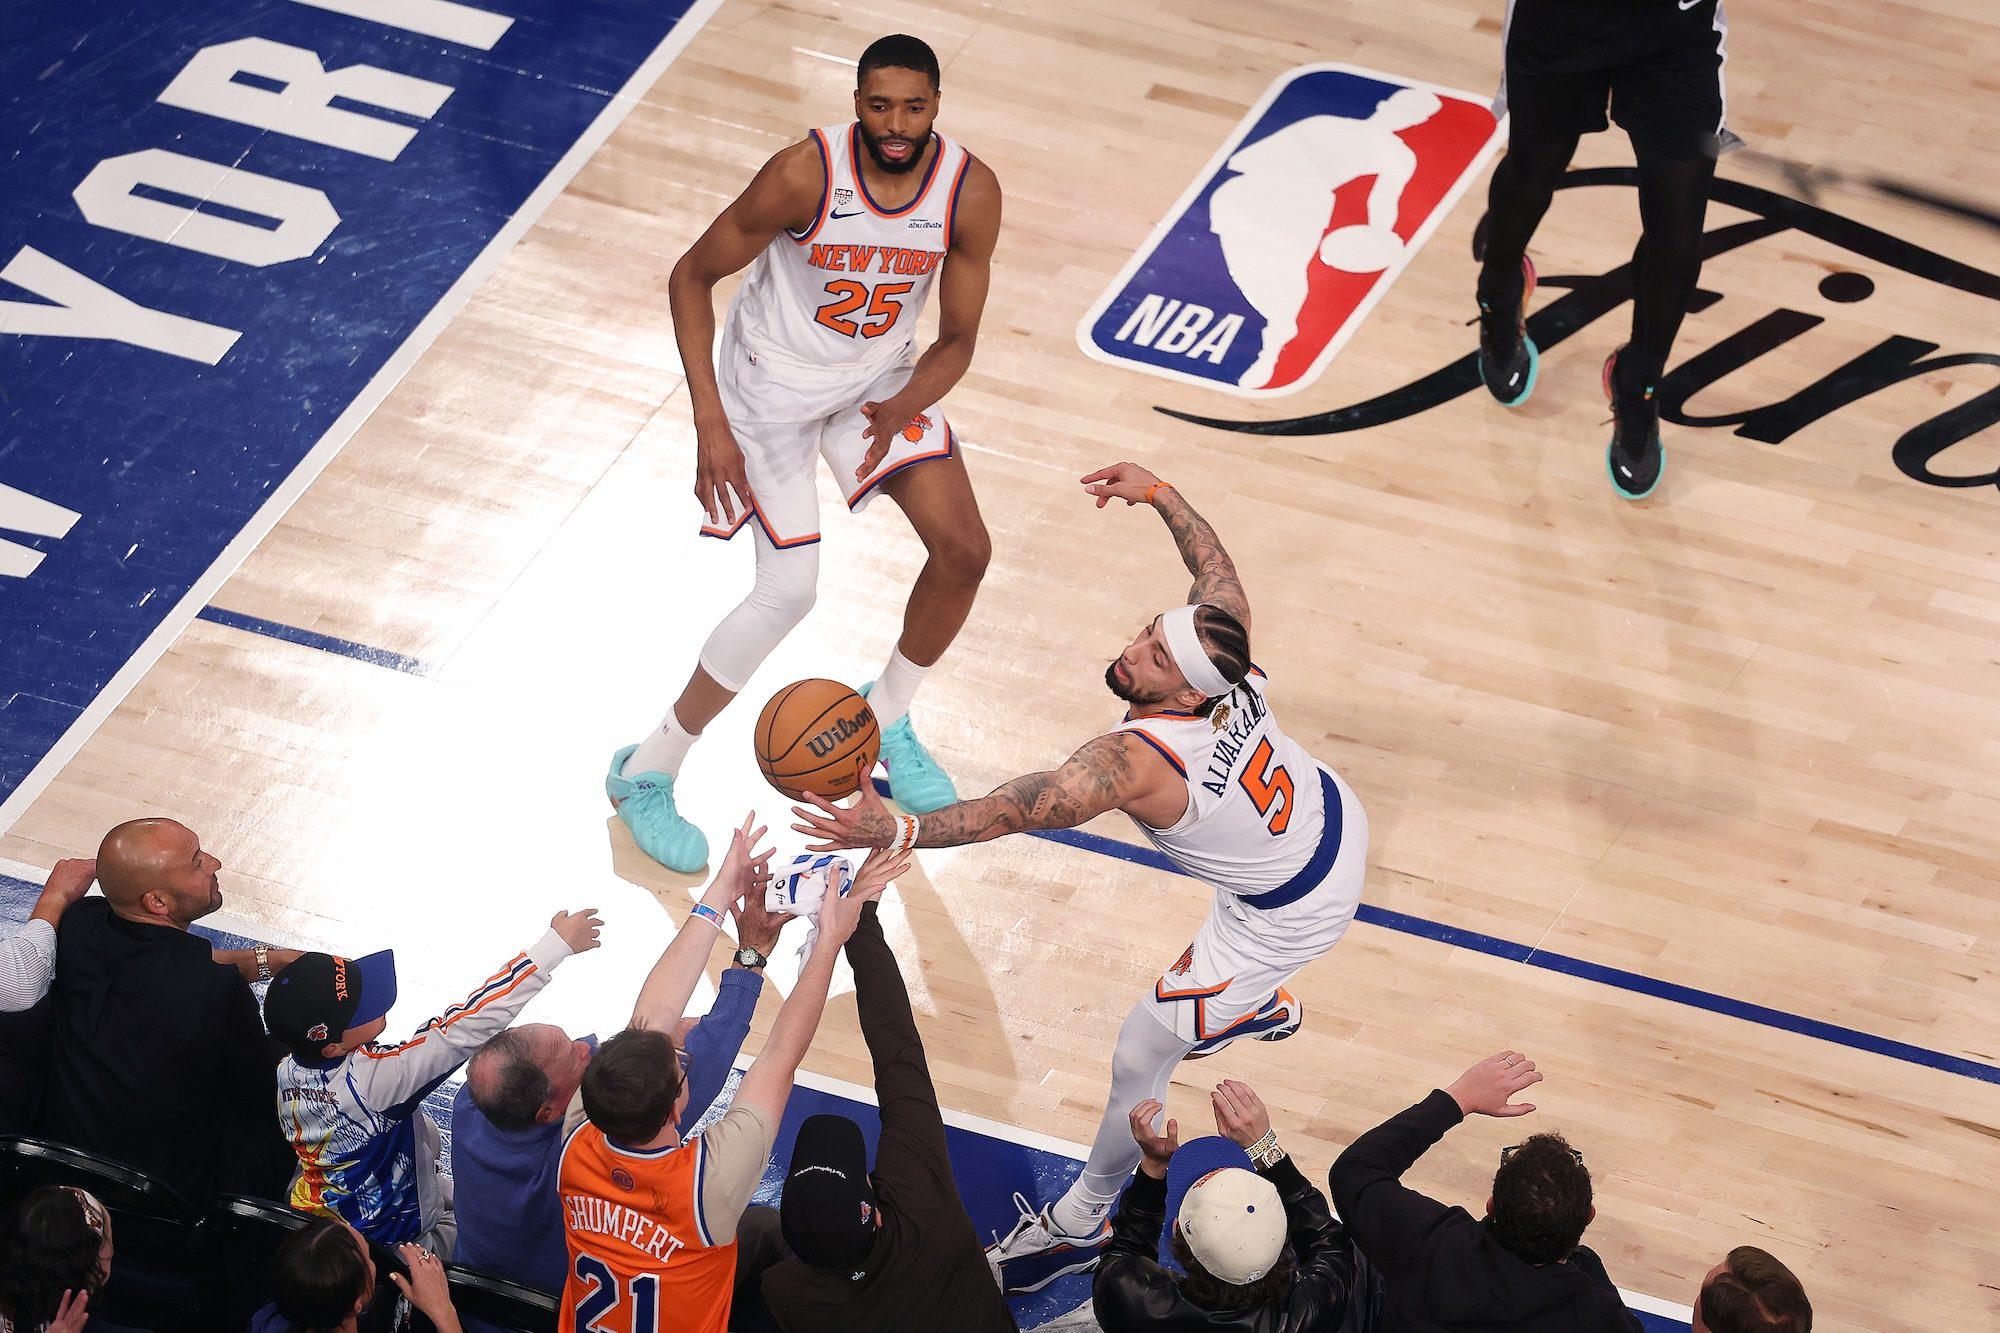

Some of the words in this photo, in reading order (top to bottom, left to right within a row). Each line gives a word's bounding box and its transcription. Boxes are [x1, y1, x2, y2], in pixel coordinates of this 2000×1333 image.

[0, 0, 515, 366] YOR
[808, 244, 877, 273] NEW
[878, 246, 946, 276] YORK
[814, 279, 915, 339] 25
[1114, 293, 1246, 365] NBA
[804, 706, 874, 758] Wilson
[1238, 733, 1294, 836] 5
[335, 967, 349, 1002] YORK
[565, 1195, 685, 1264] SHUMPERT
[575, 1251, 661, 1333] 21
